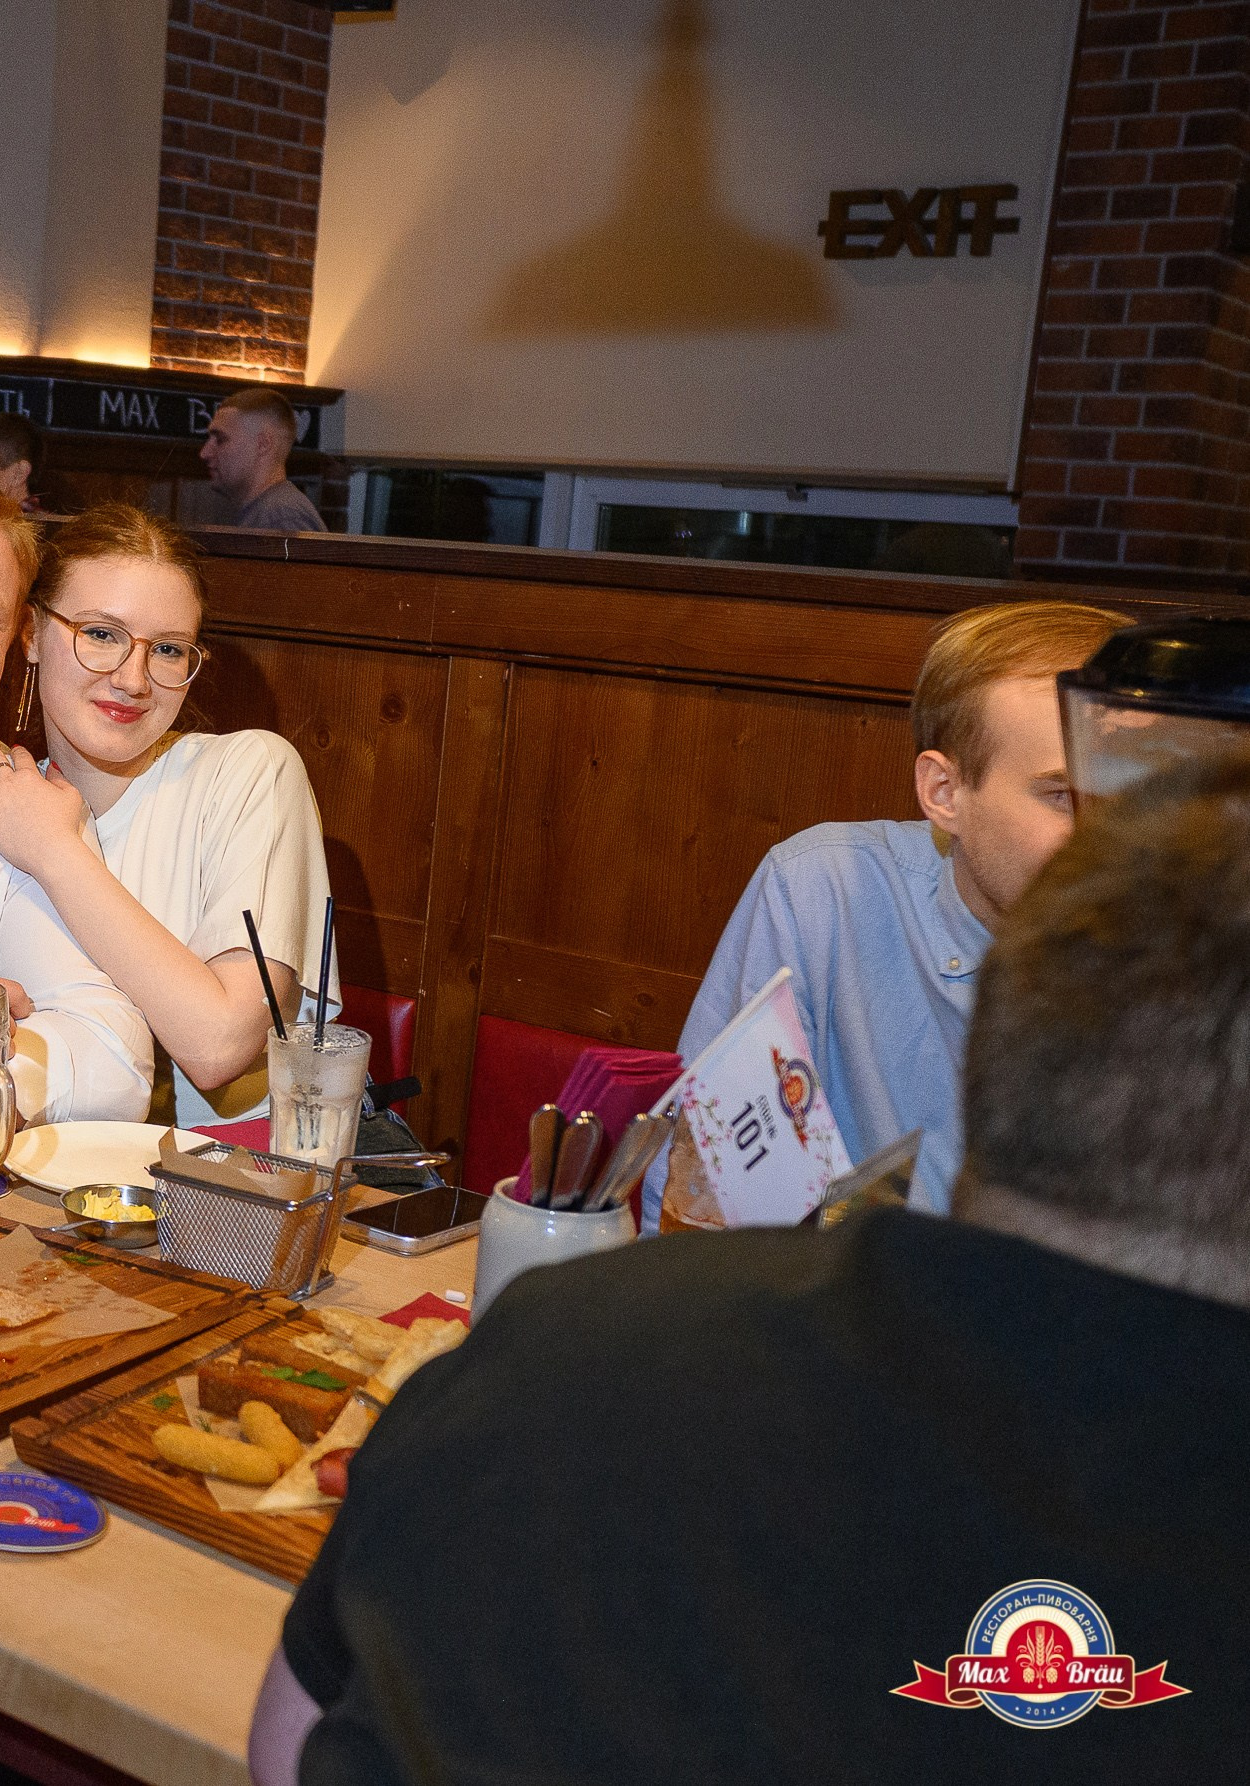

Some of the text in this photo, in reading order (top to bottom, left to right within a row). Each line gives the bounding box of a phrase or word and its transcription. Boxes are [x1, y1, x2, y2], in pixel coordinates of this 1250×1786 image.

[817, 183, 1020, 260] EXIT
[100, 390, 160, 430] MAX
[729, 1102, 770, 1172] 101
